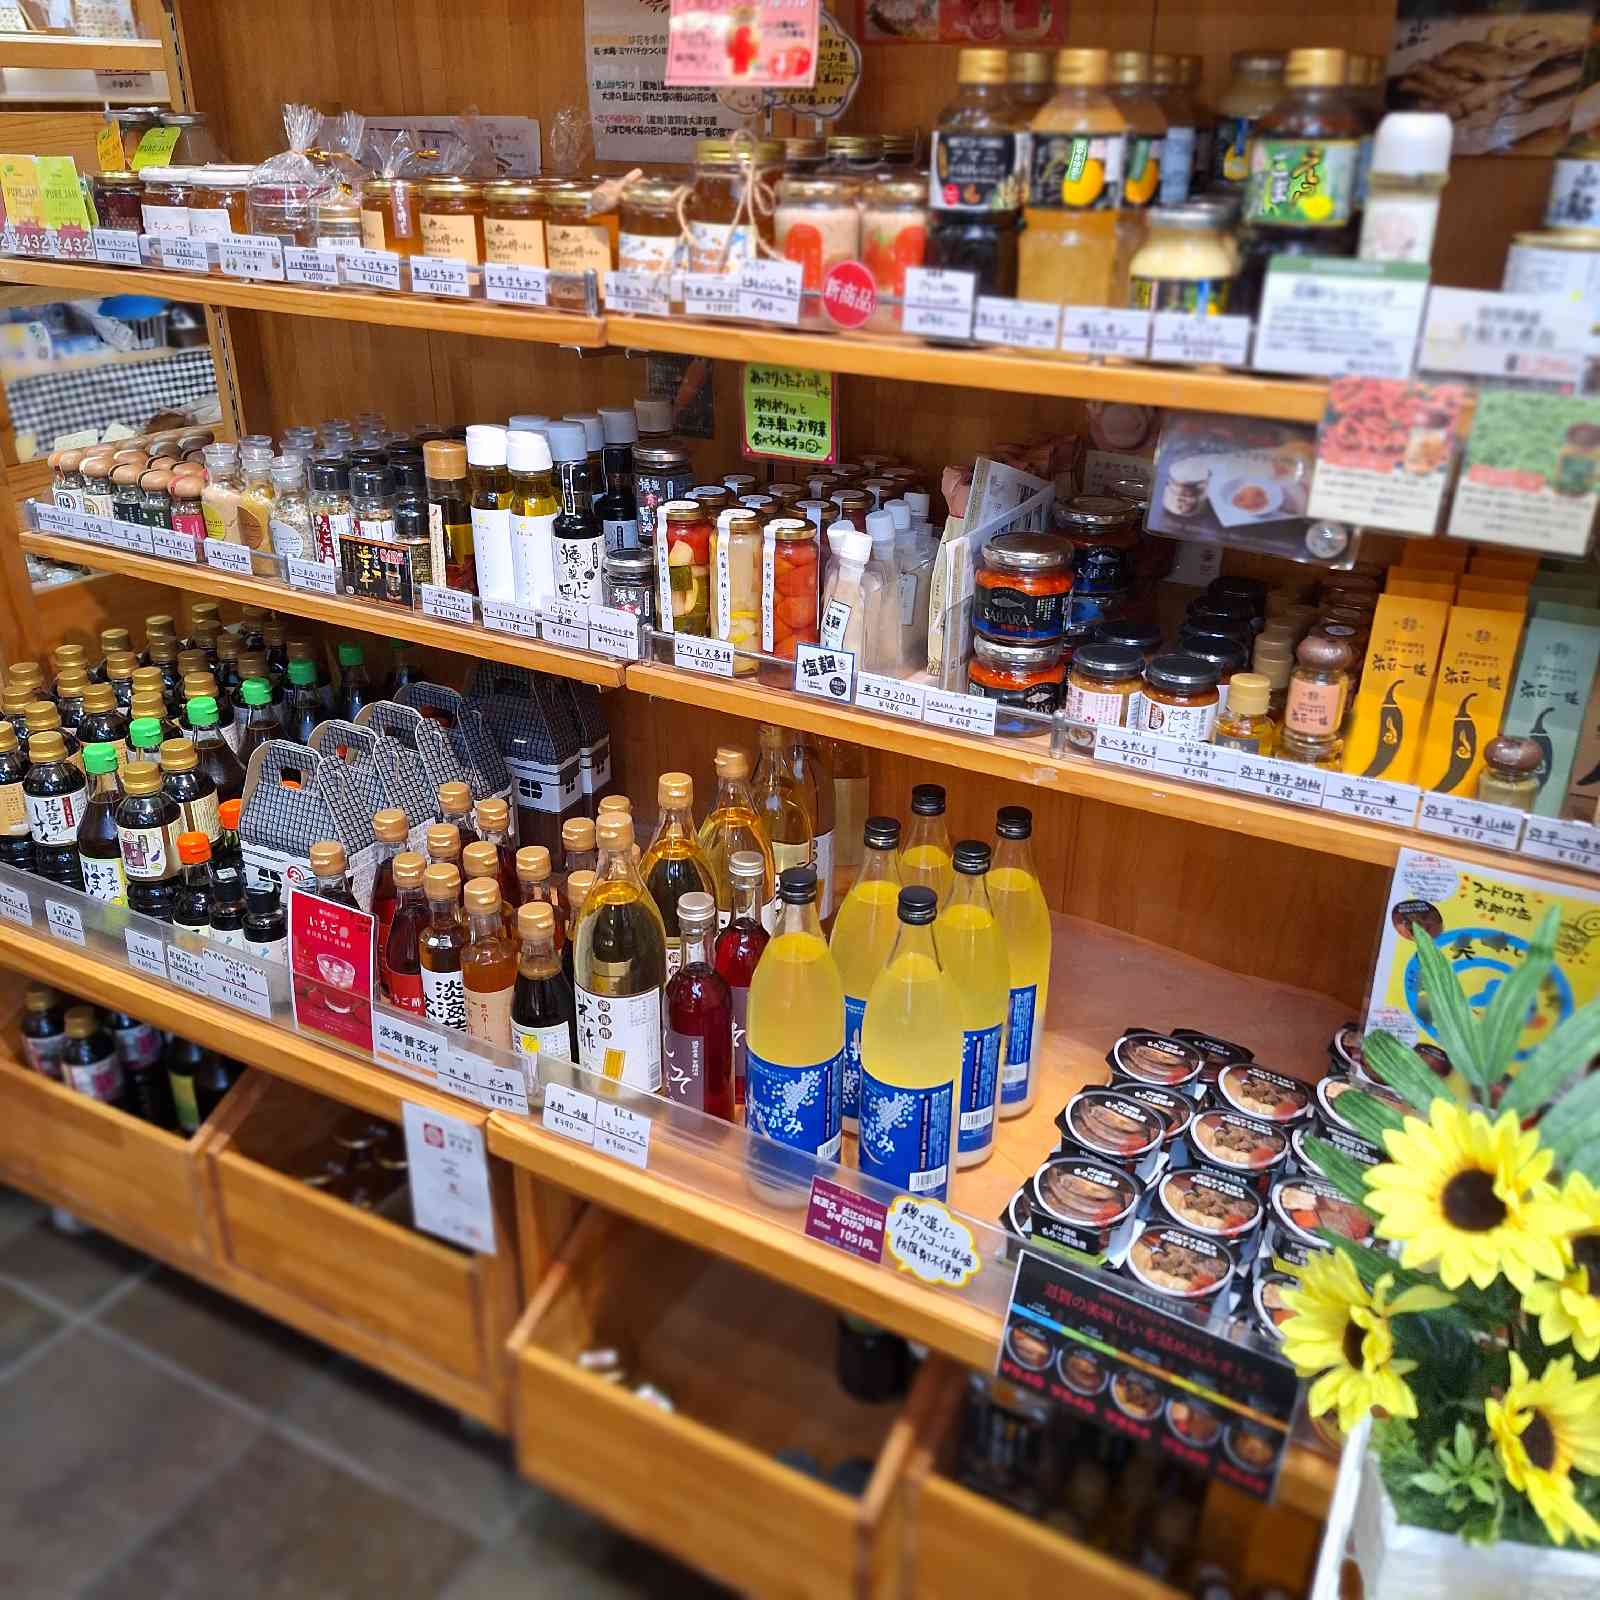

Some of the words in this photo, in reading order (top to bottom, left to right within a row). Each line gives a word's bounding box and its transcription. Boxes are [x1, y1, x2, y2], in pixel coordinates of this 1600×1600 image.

[345, 258, 398, 273] さくらはちみつ
[823, 279, 873, 312] 新商品
[549, 604, 578, 618] にんにく
[676, 642, 731, 662] ピクルス各種
[693, 659, 714, 670] ¥200
[1240, 763, 1321, 791] 弥平柚子胡椒
[1341, 785, 1397, 805] 弥平一味
[1472, 880, 1526, 904] フードロス
[840, 1228, 874, 1250] 1051円
[895, 1217, 972, 1267] ノンアルコール甘酒
[896, 1235, 962, 1280] 防腐剤不使用
